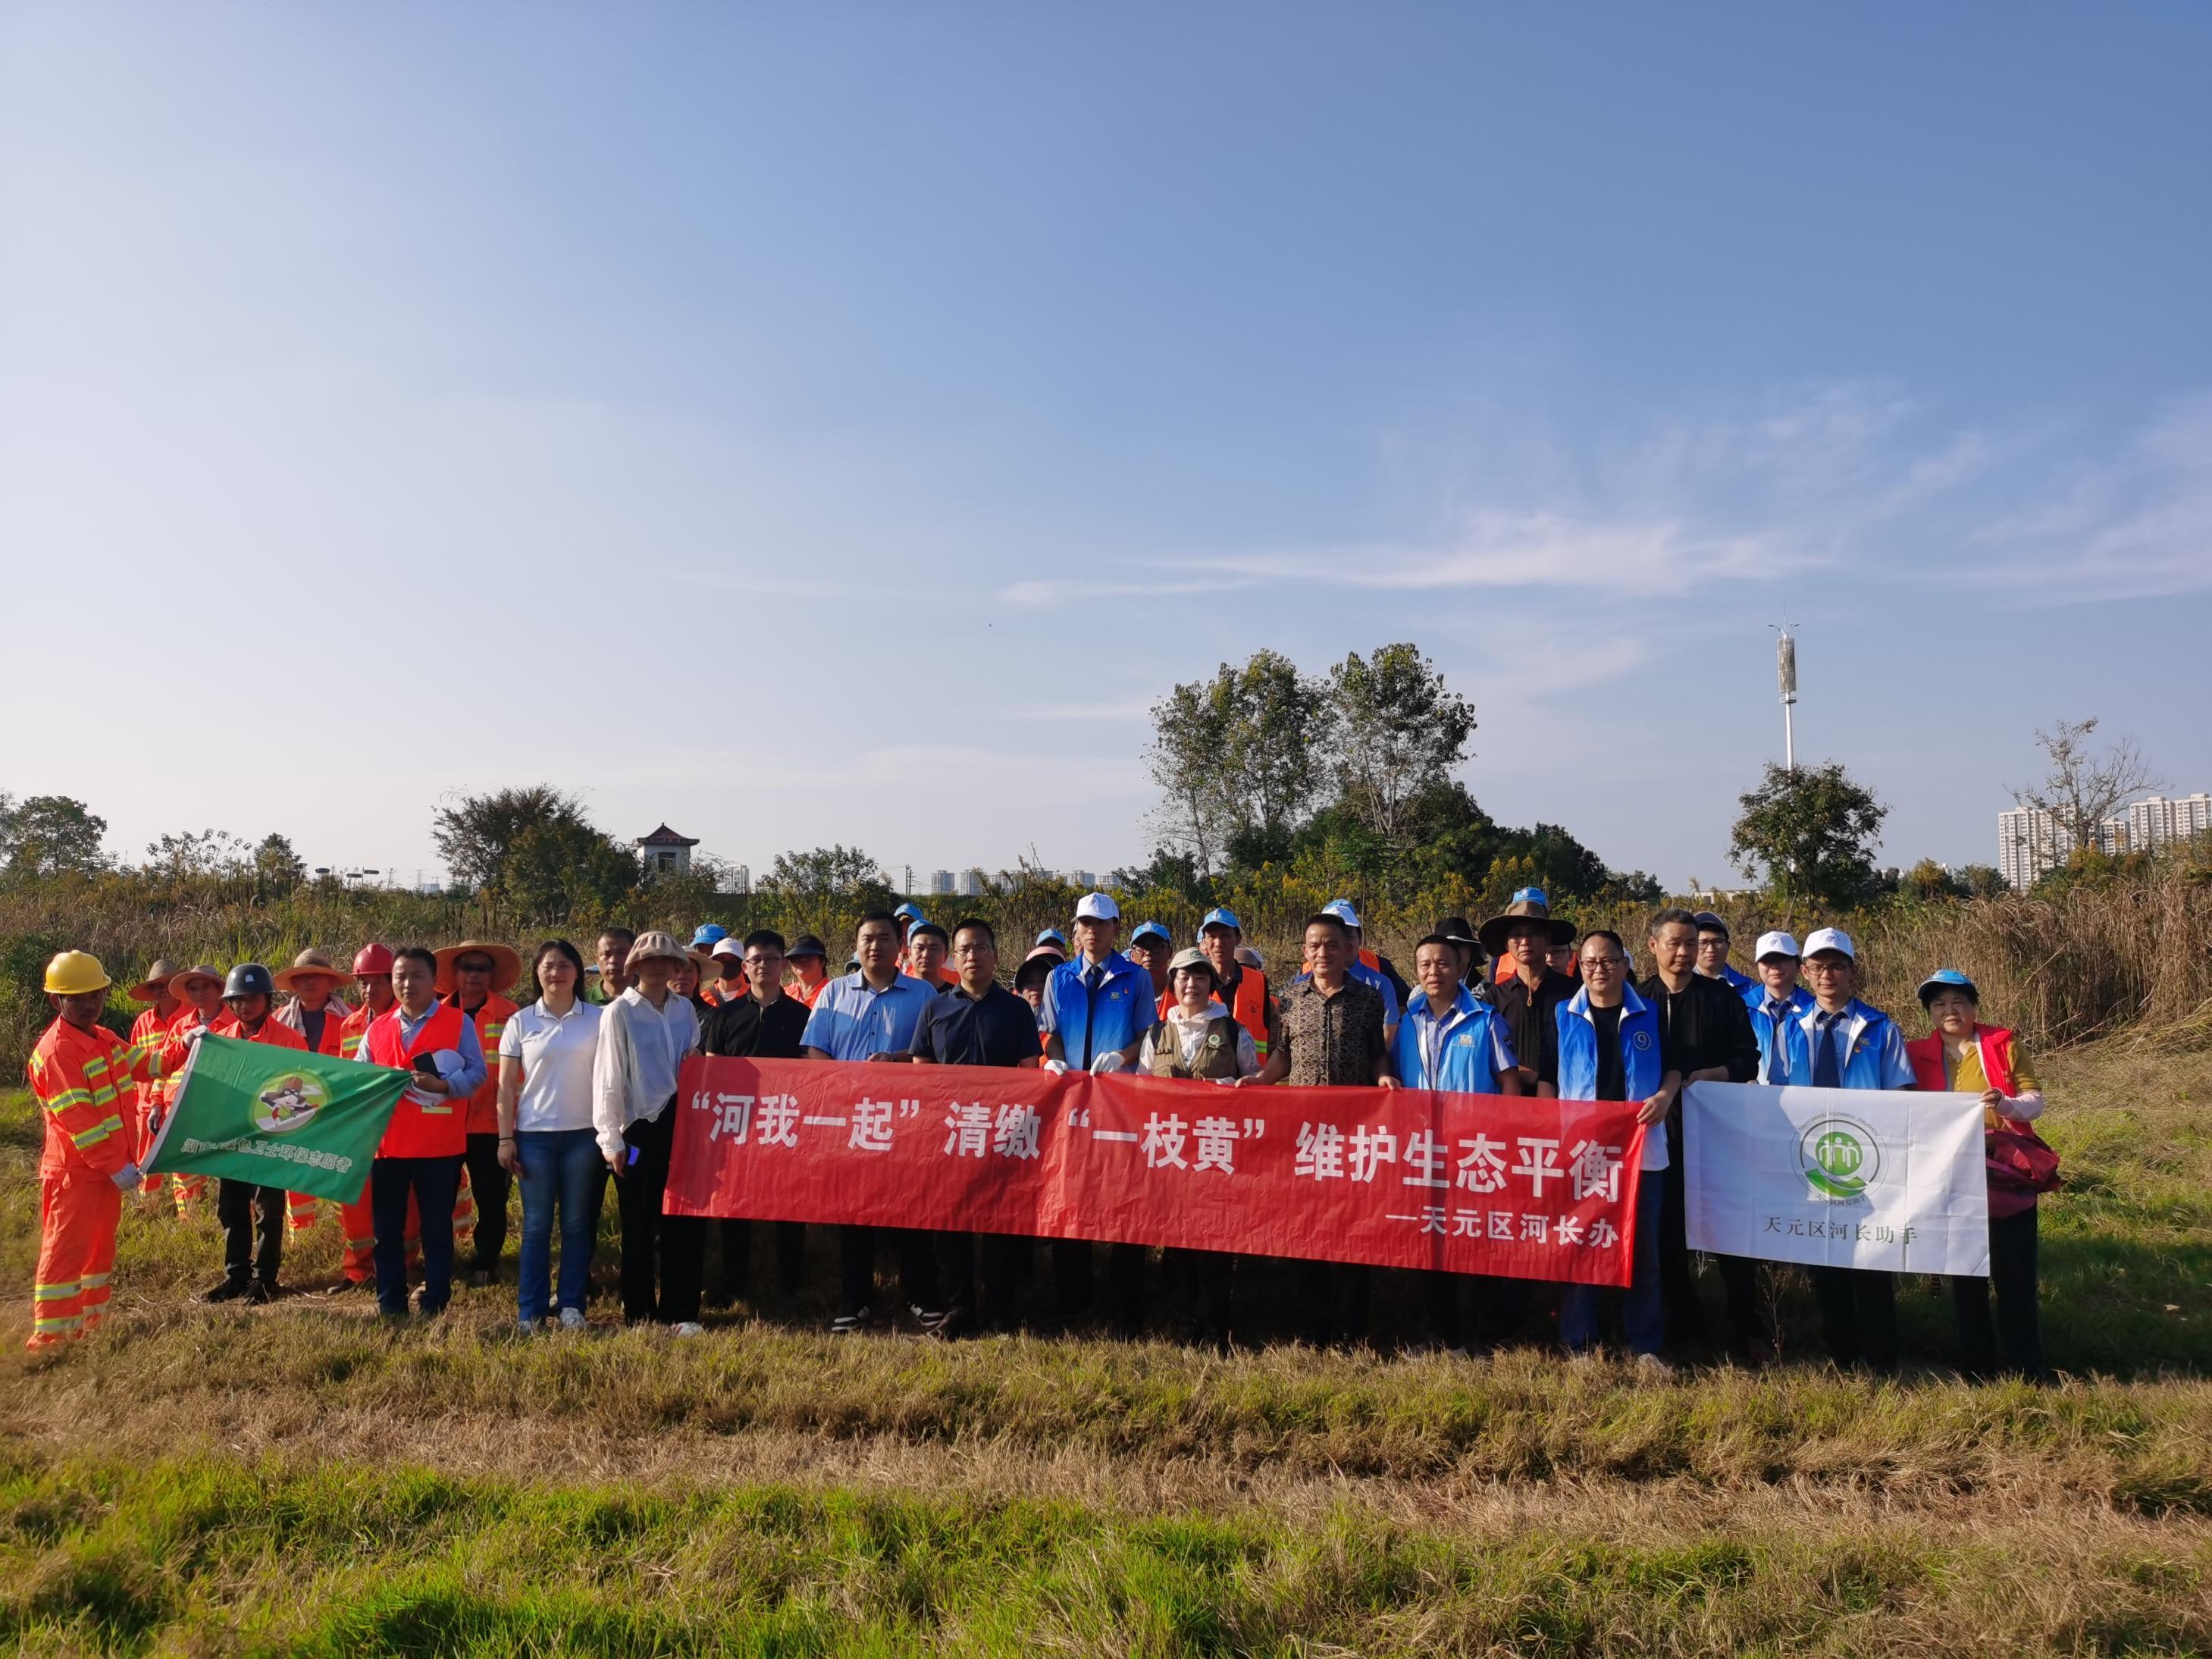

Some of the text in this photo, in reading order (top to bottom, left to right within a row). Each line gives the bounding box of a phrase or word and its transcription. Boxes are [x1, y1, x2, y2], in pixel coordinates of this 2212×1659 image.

[691, 1090, 1623, 1202] “河我一起” 清缴 “一枝黄” 维护生态平衡
[1762, 1216, 1918, 1245] 天元区河长助手
